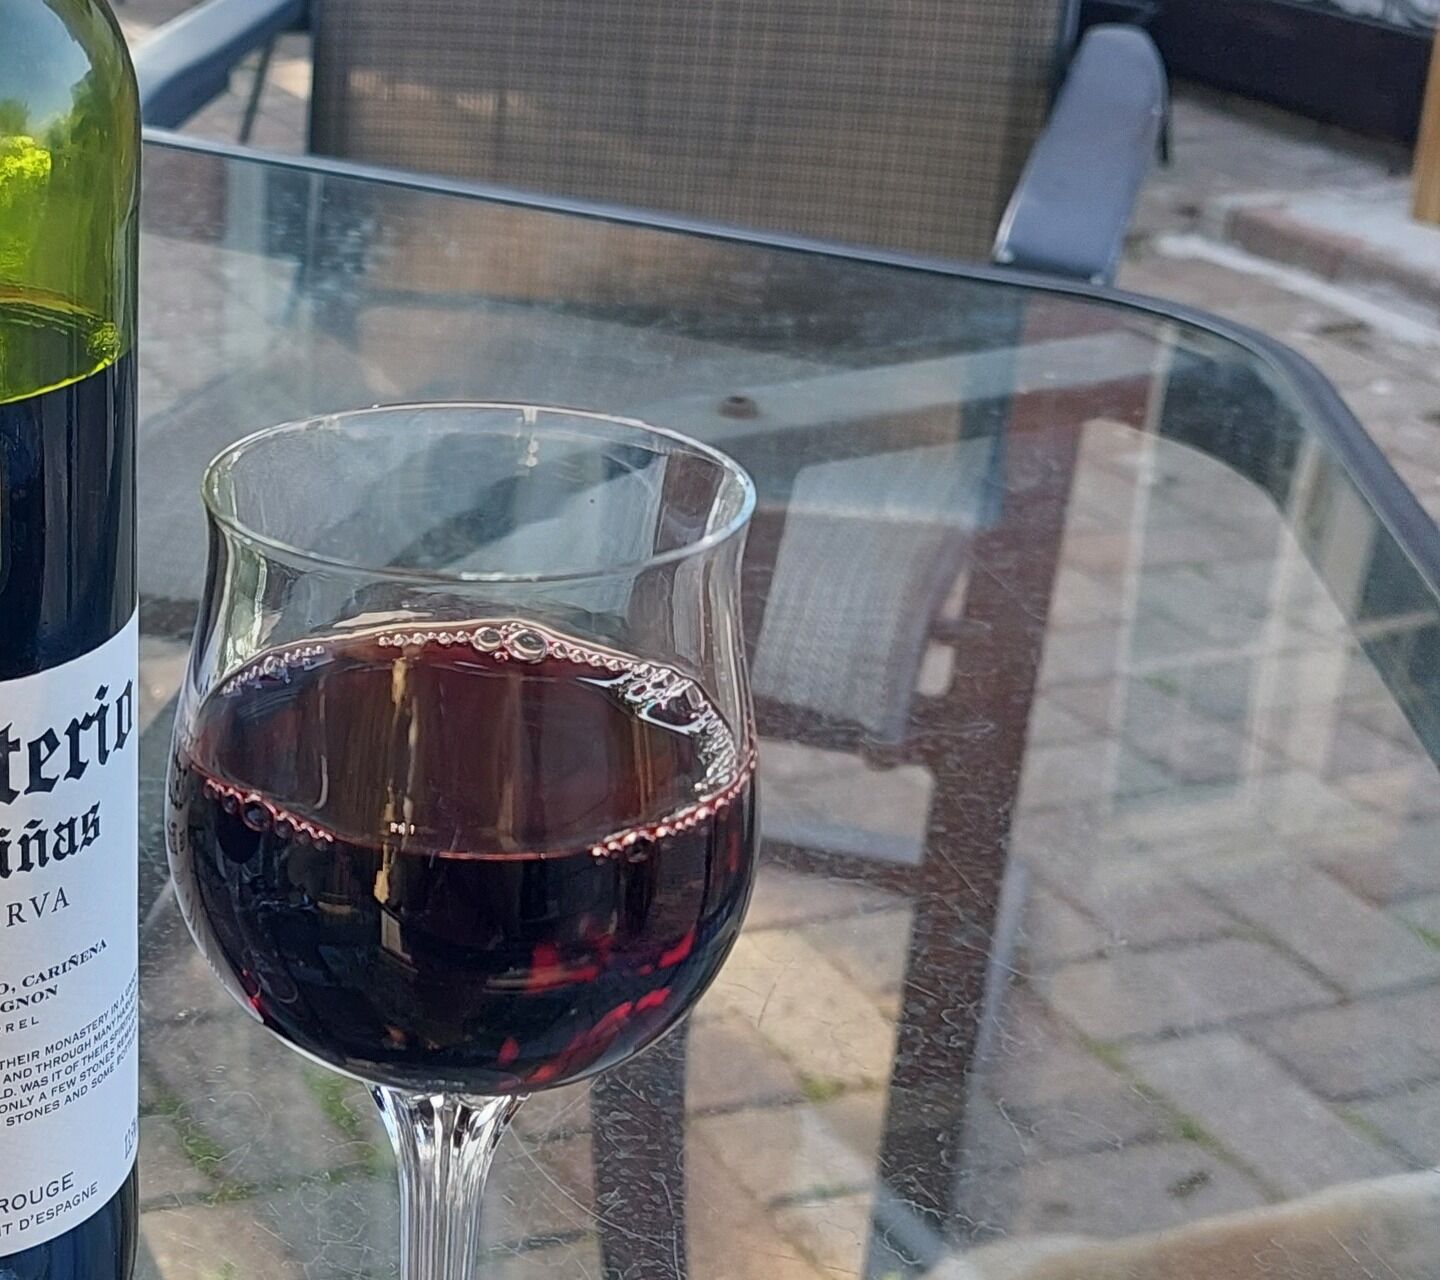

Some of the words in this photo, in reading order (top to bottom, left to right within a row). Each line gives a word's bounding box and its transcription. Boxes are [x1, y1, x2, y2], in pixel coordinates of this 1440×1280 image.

[22, 939, 108, 988] CARIÑENA
[45, 1010, 109, 1057] MONASTERY
[3, 1067, 33, 1084] AND
[36, 1039, 92, 1073] THROUGH
[20, 1075, 49, 1093] WAS
[51, 1070, 63, 1083] IT
[64, 1061, 80, 1075] OF
[80, 1040, 109, 1066] THEIR
[38, 1091, 48, 1103] A
[51, 1076, 77, 1097] FEW
[79, 1048, 115, 1083] STONES
[6, 1100, 60, 1127] STONES
[64, 1085, 89, 1106] AND
[91, 1062, 115, 1089] SOME
[19, 1181, 98, 1231] D'ESPAGNE
